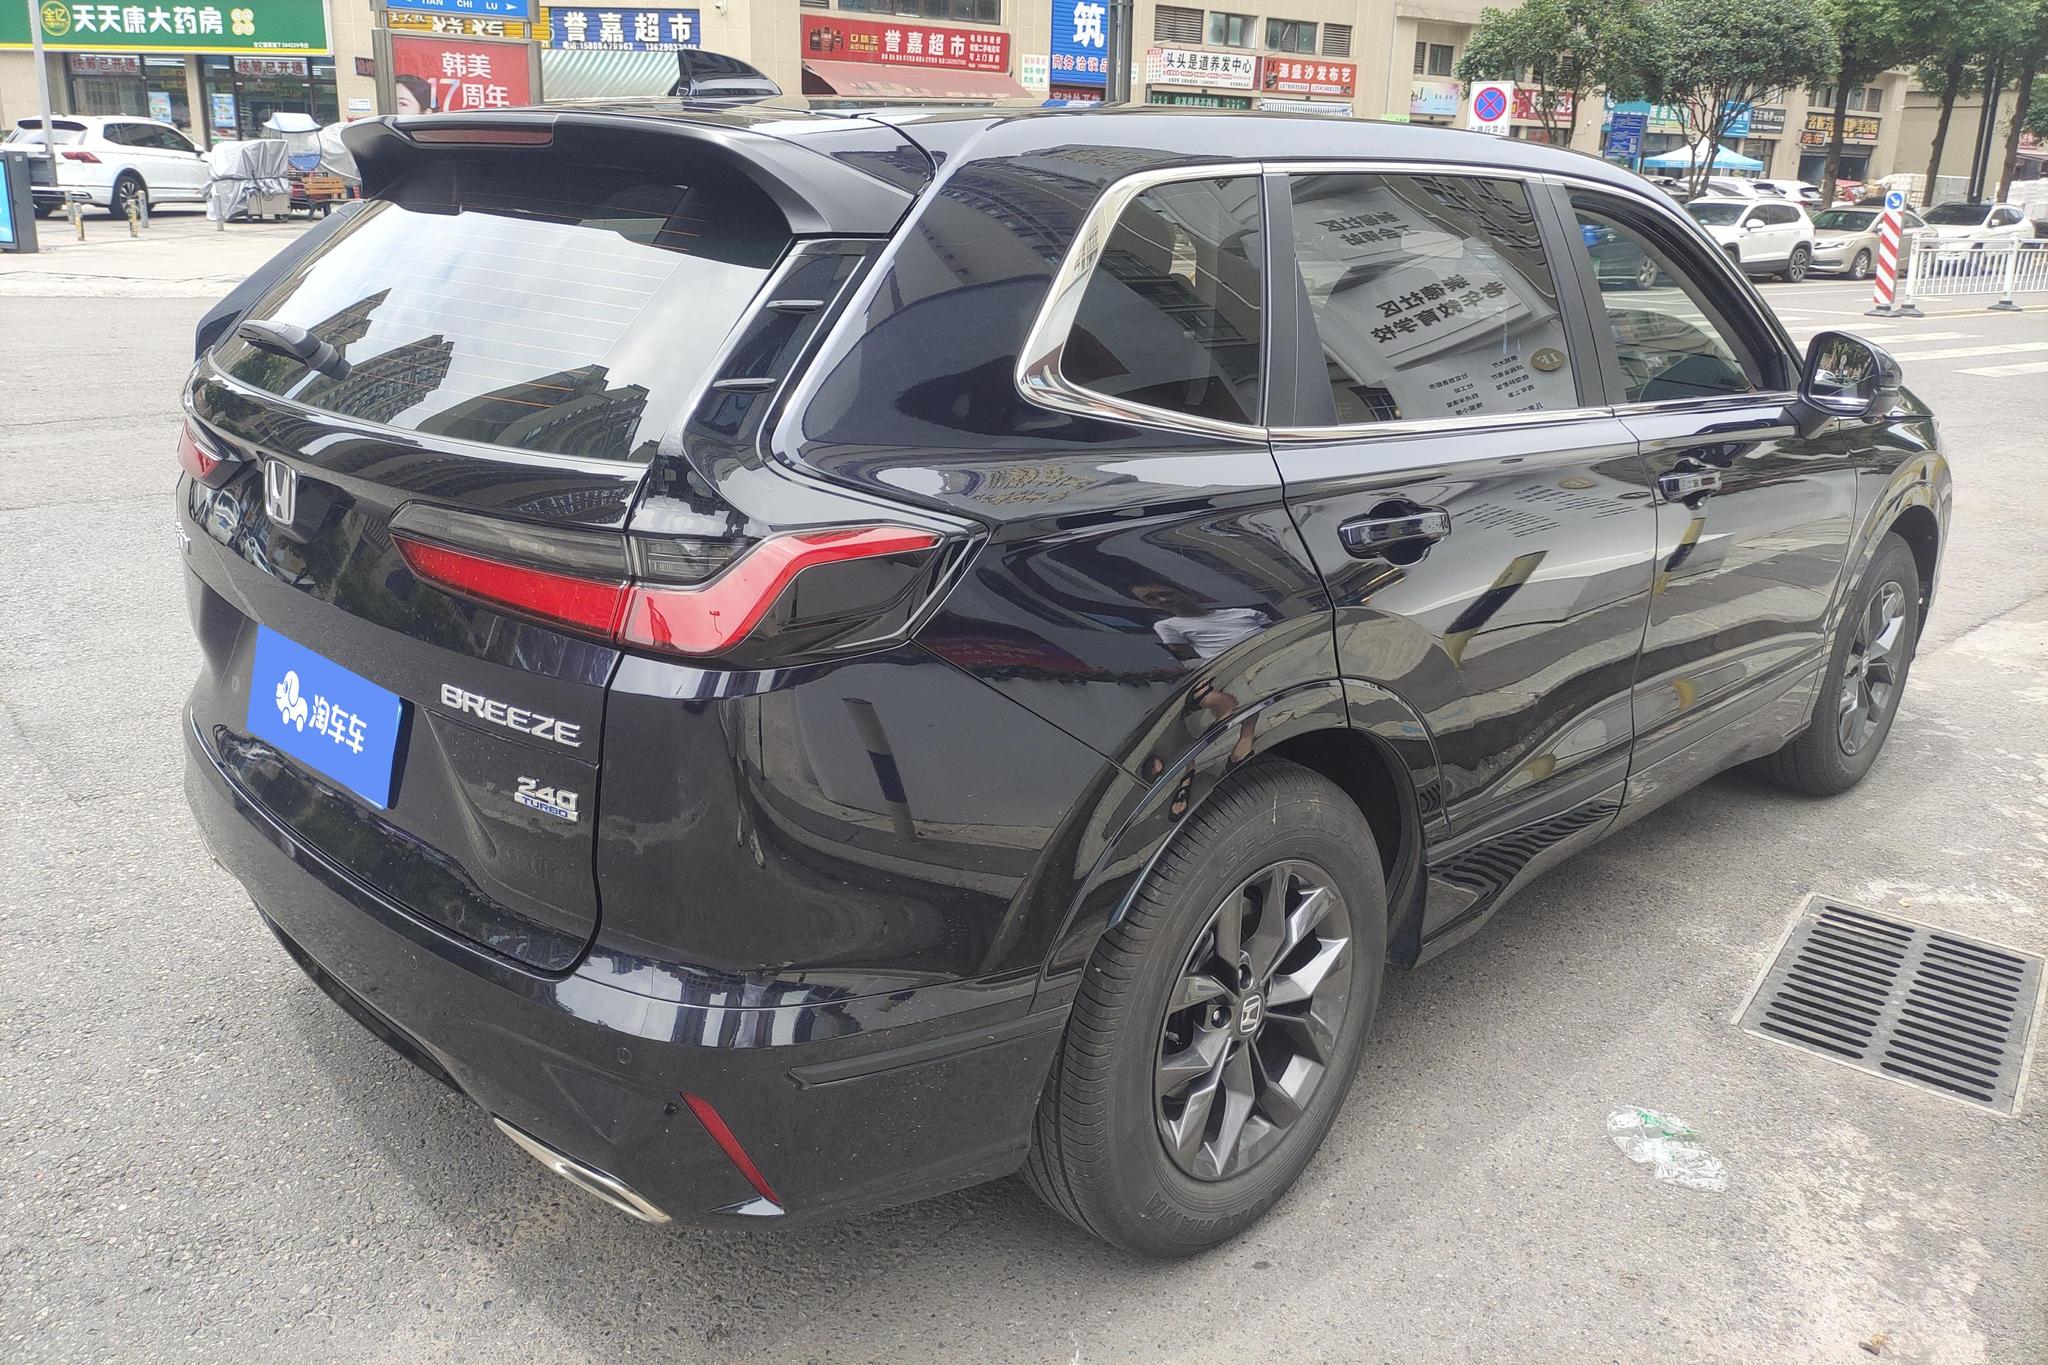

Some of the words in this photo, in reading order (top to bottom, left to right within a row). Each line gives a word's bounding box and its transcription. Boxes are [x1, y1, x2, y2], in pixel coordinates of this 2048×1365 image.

[72, 5, 223, 34] 天天康大药房
[456, 0, 472, 8] CHI
[486, 2, 498, 10] LU
[564, 11, 692, 42] 誉嘉超市
[1072, 2, 1105, 48] 筑
[883, 29, 966, 58] 誉嘉超市
[441, 51, 493, 79] 韩美
[1166, 52, 1253, 74] 头头是道养发中心
[441, 683, 583, 748] BREEZE
[517, 776, 579, 812] 240
[522, 796, 568, 818] TURBO
